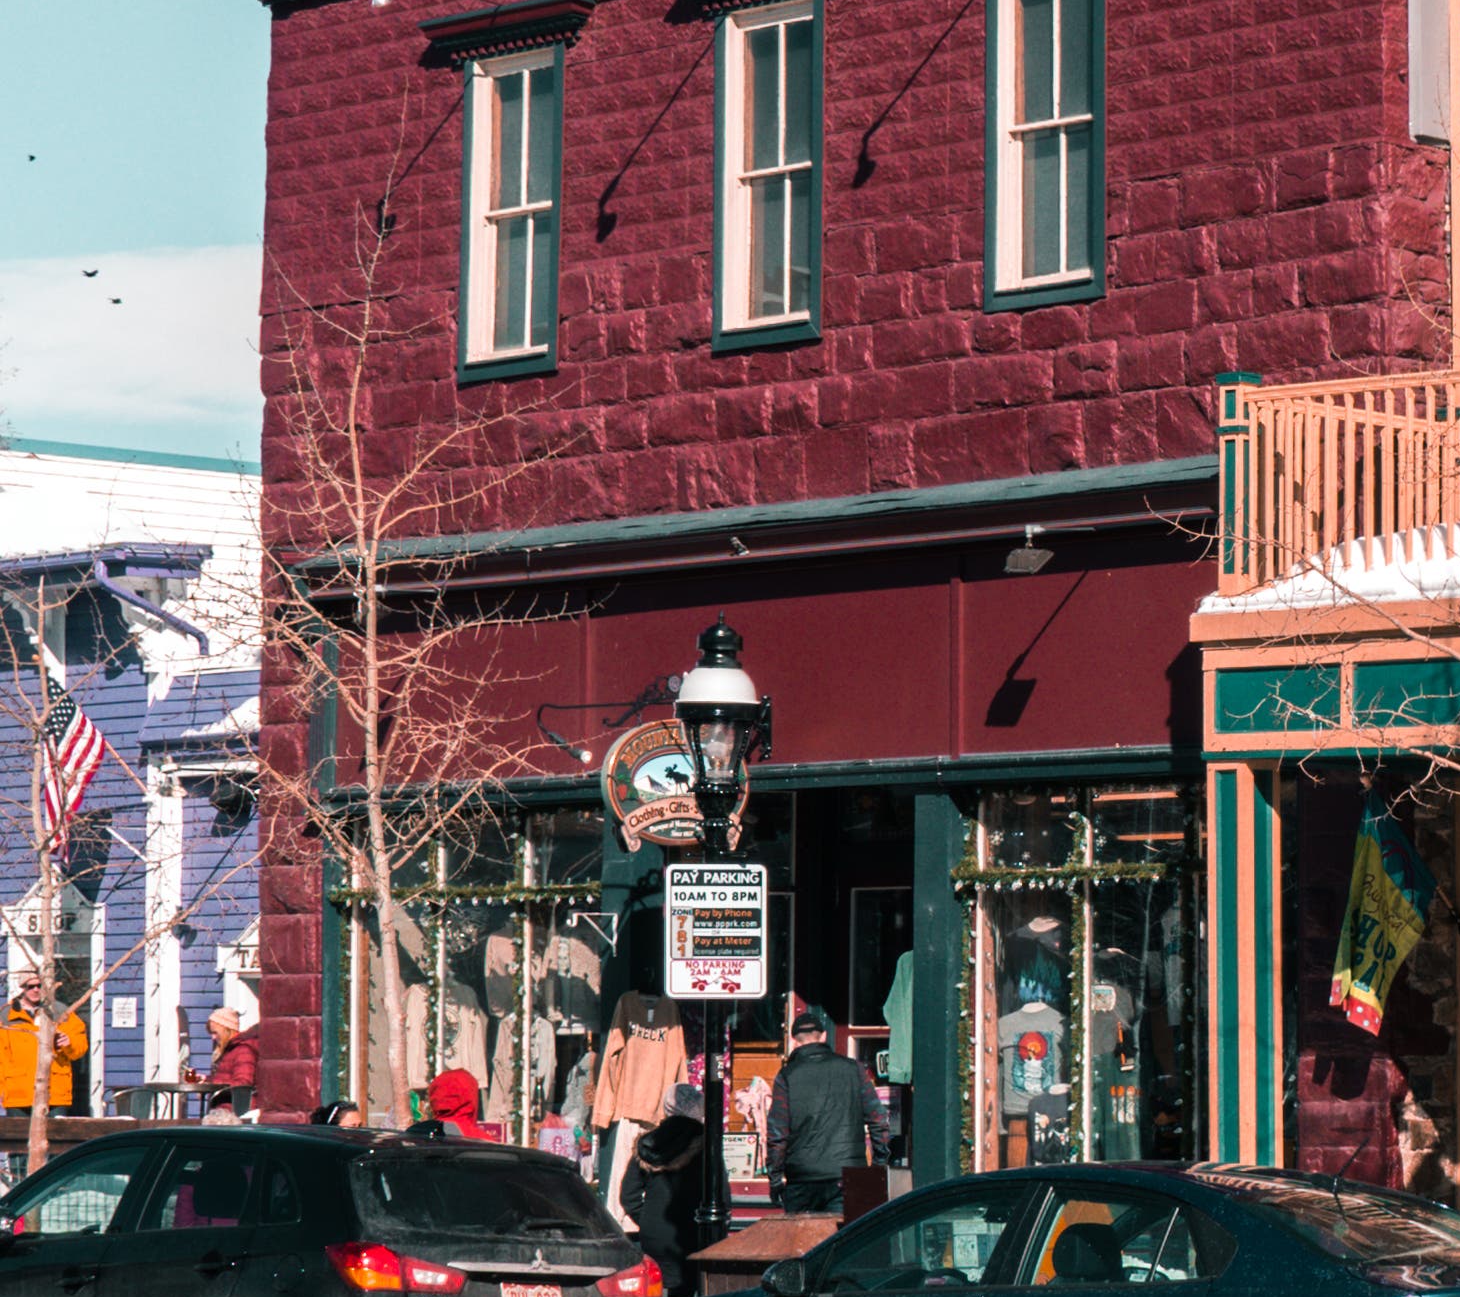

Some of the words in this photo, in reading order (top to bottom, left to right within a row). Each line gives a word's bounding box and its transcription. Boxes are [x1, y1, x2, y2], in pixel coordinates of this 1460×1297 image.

[629, 806, 666, 828] Clothing
[669, 801, 690, 814] Gifts
[673, 871, 699, 884] PAY
[703, 871, 760, 884] PARKING
[674, 892, 706, 901] 10AM
[711, 892, 727, 901] TO
[732, 892, 758, 901] 8PM
[694, 909, 711, 920] Pay
[711, 909, 723, 919] by
[724, 909, 752, 918] Phone
[28, 912, 77, 932] SOP
[695, 937, 711, 947] Pay
[713, 937, 723, 945] at
[725, 937, 752, 945] Meter
[237, 949, 260, 968] TA
[685, 960, 700, 969] NO
[702, 960, 746, 969] PARKING
